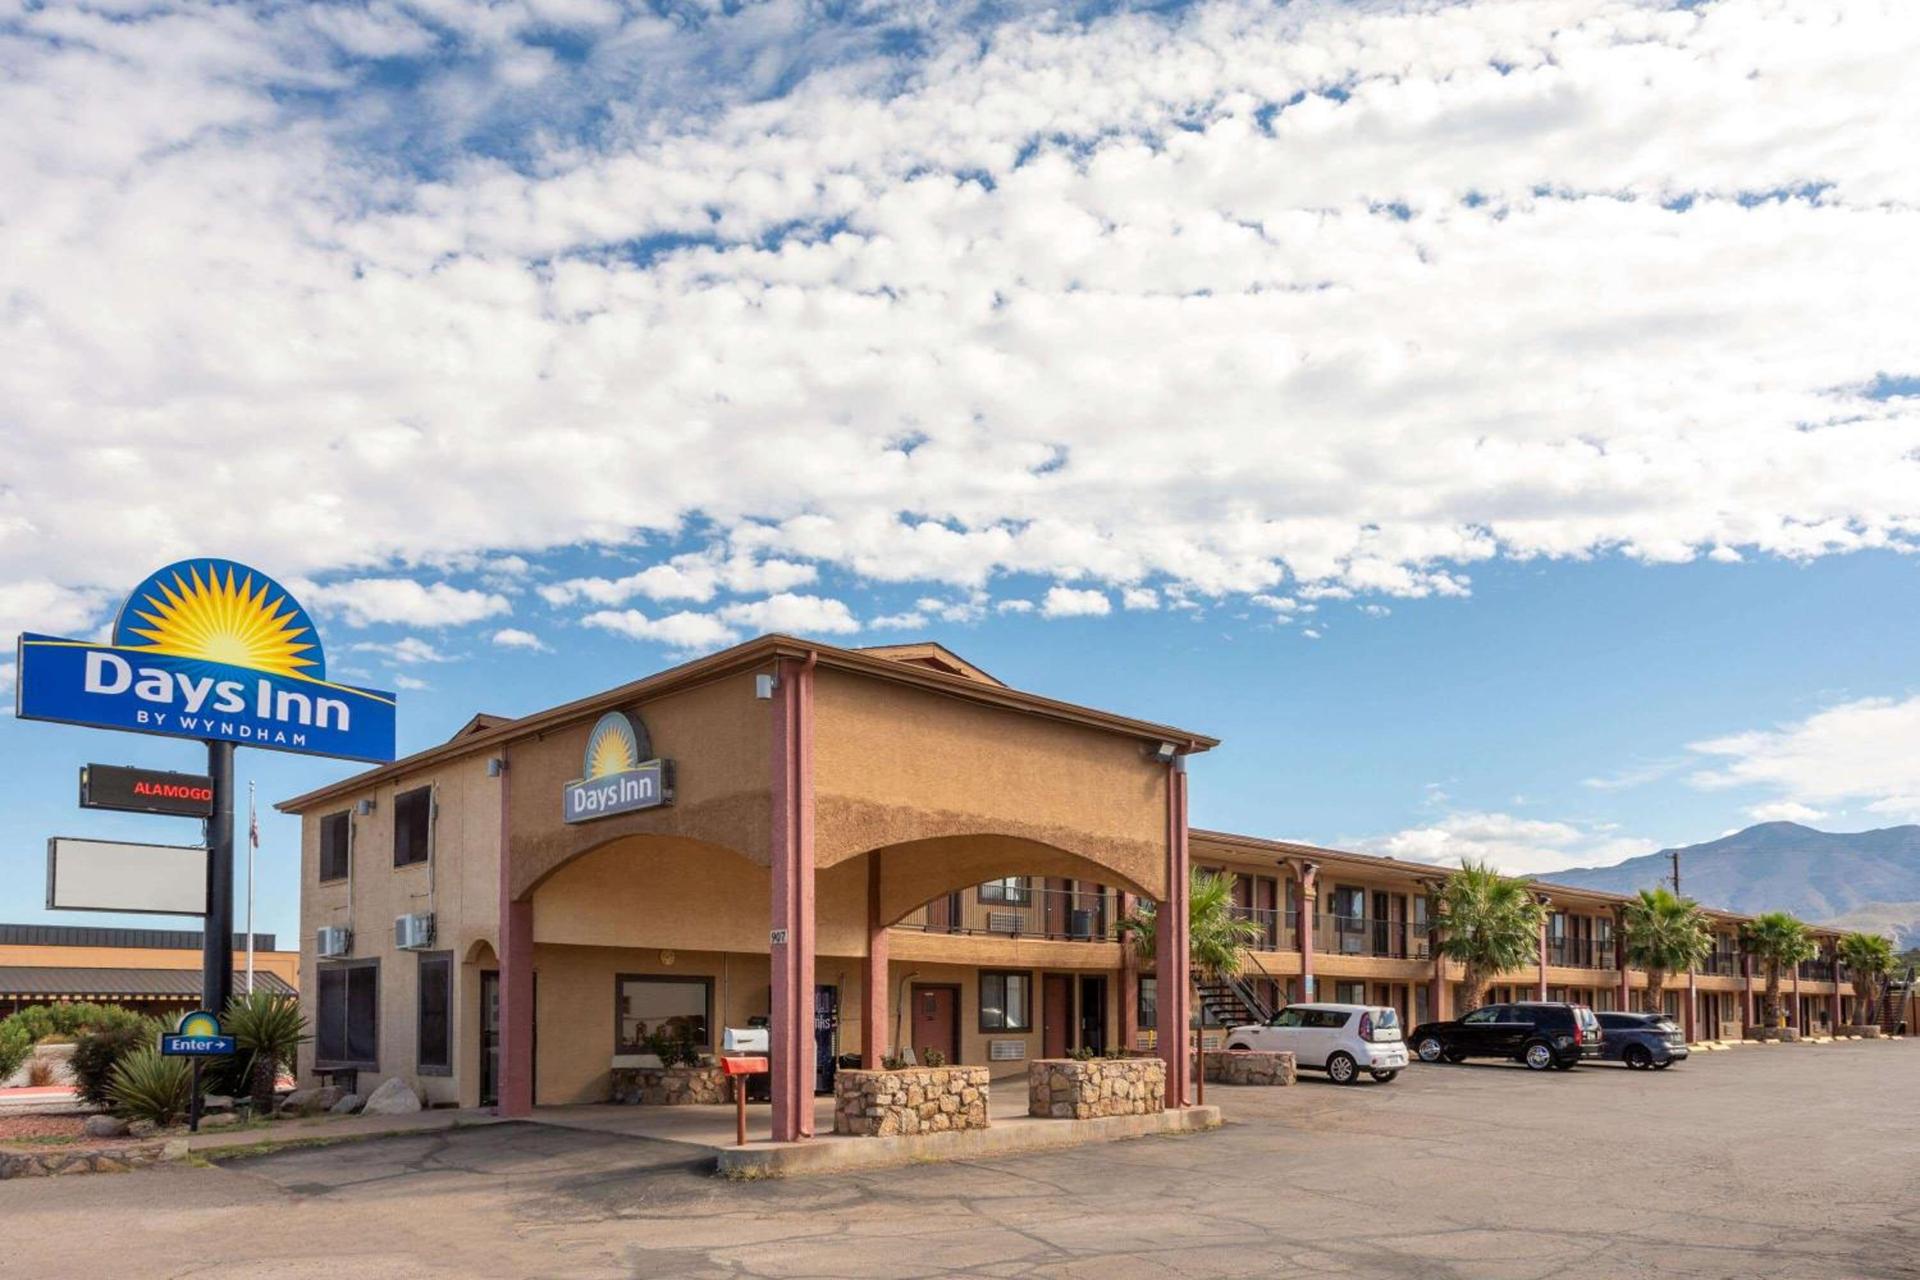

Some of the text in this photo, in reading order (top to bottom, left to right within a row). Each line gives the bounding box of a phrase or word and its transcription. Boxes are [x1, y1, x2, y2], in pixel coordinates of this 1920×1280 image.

[84, 651, 350, 732] Days Inn
[136, 710, 306, 747] BY WYNDHAM
[133, 781, 213, 801] ALAMOGO
[573, 777, 652, 813] Days Inn
[171, 1039, 214, 1051] Enter
